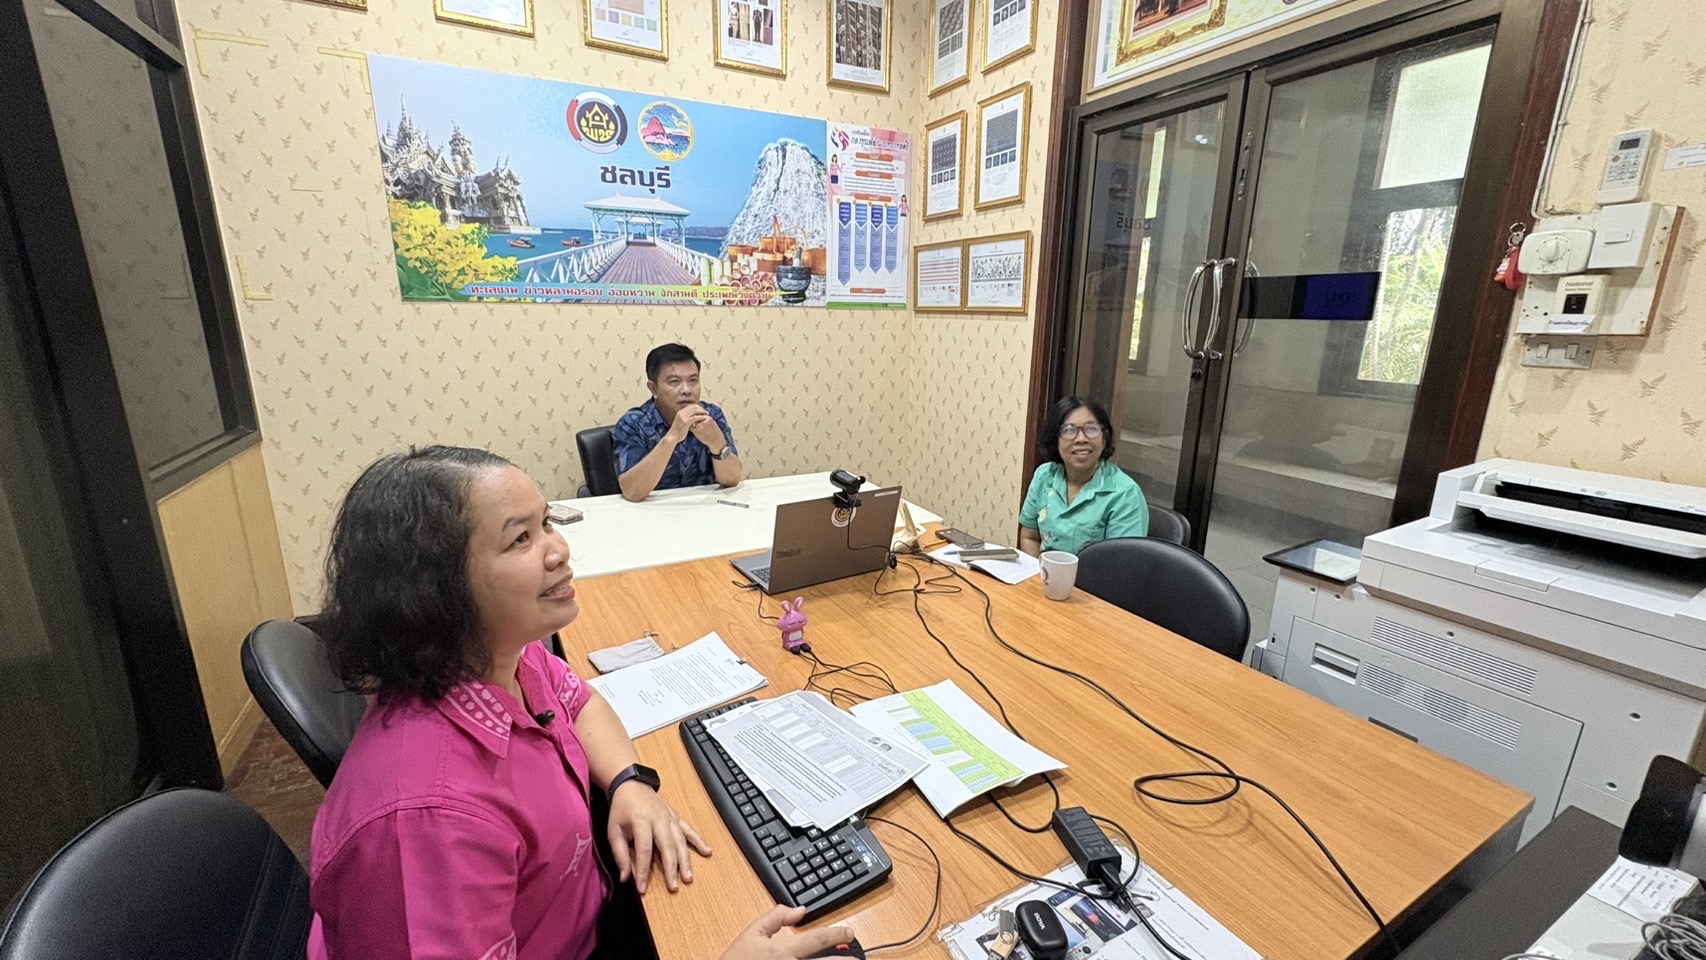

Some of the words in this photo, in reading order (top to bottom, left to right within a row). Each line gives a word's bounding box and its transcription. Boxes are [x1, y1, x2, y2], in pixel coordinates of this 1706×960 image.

[600, 165, 671, 194] ชลบุรี
[470, 285, 518, 294] ทะเลงาม
[608, 285, 655, 297] อ้อยหวาน
[660, 287, 697, 298] จักสานดี
